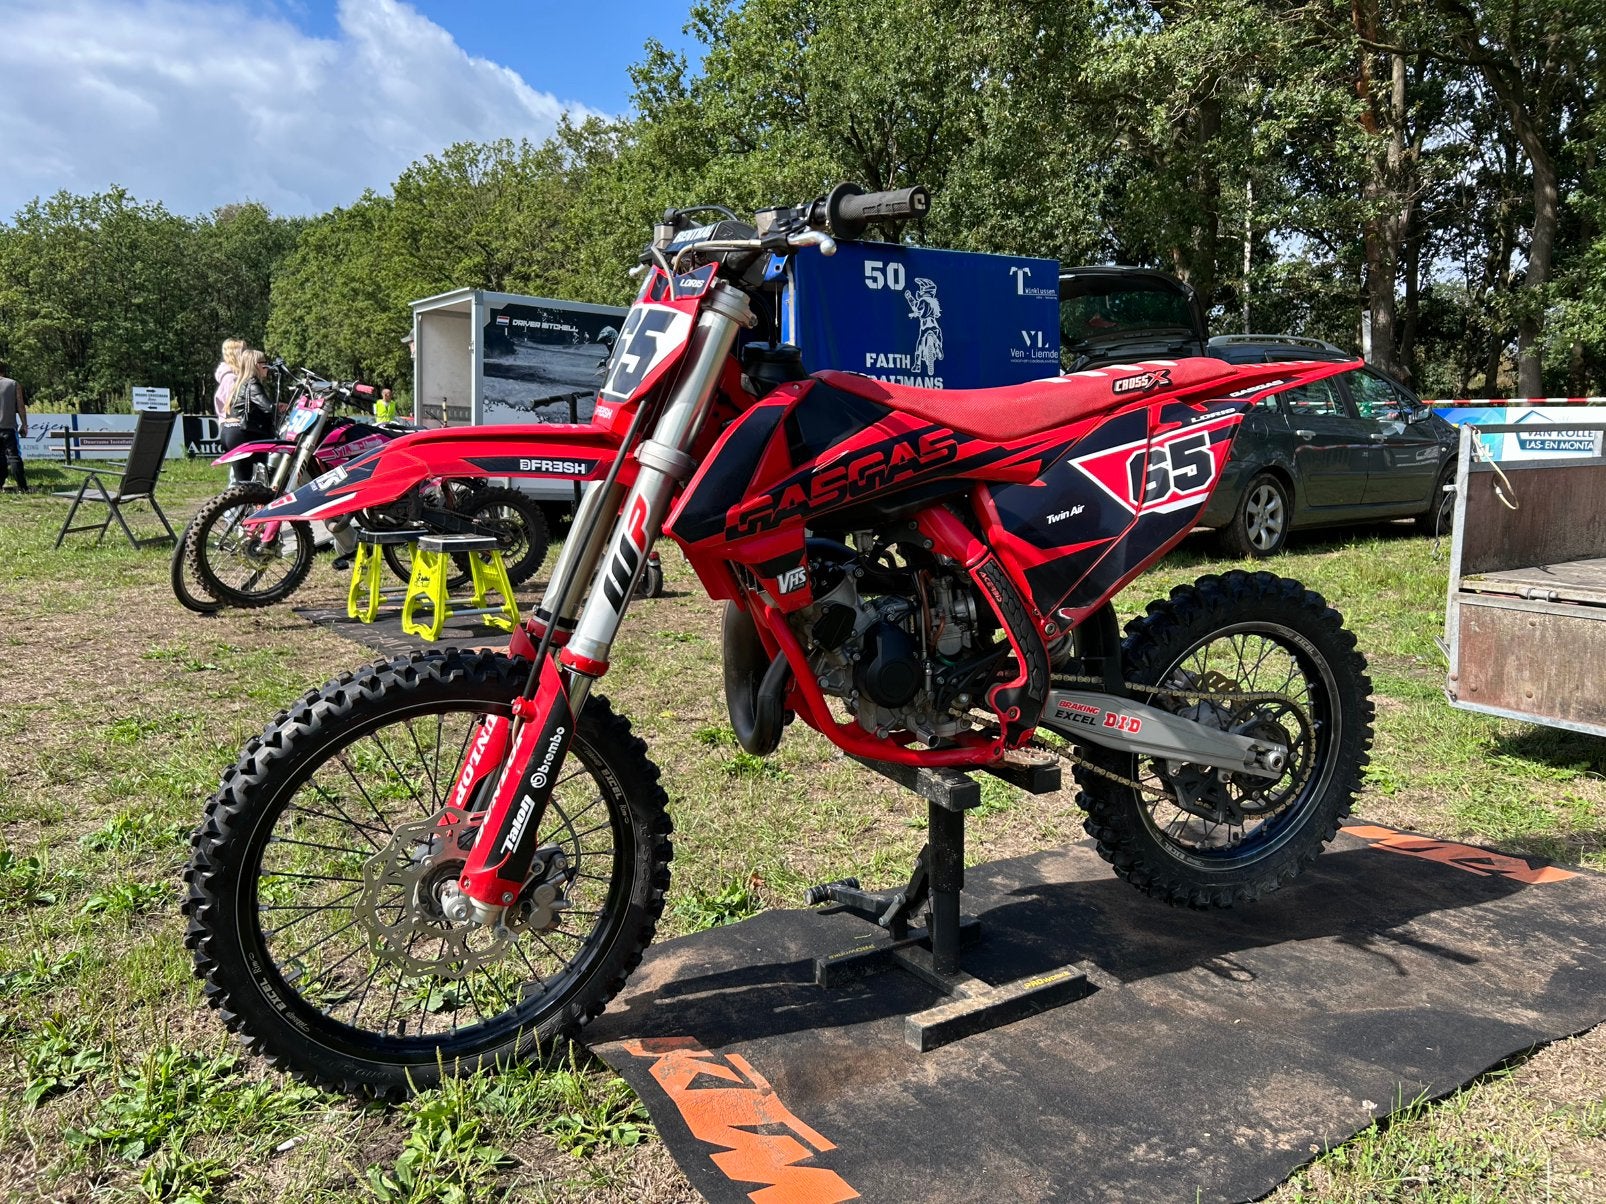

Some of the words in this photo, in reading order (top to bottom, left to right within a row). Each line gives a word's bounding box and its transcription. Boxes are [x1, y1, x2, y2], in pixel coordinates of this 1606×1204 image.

[679, 278, 705, 288] LORIS
[864, 260, 906, 291] 50
[512, 319, 541, 328] DRIVER
[865, 352, 910, 369] FAITH
[1010, 348, 1025, 358] Ven
[1031, 349, 1059, 359] Liemde
[1190, 407, 1236, 423] LORIS
[1545, 441, 1557, 449] EN
[1127, 432, 1215, 506] 65
[724, 428, 958, 541] GASGAS
[1046, 509, 1069, 525] Twin
[1070, 503, 1085, 519] Air
[776, 566, 806, 594] VHS
[1054, 709, 1097, 726] EXCEL
[1057, 699, 1101, 716] BRAKING
[456, 714, 498, 806] UNLOP
[540, 726, 565, 775] brembo
[601, 768, 624, 800] EXCEL
[500, 794, 536, 854] Talon
[260, 977, 287, 1012] EXCEL
